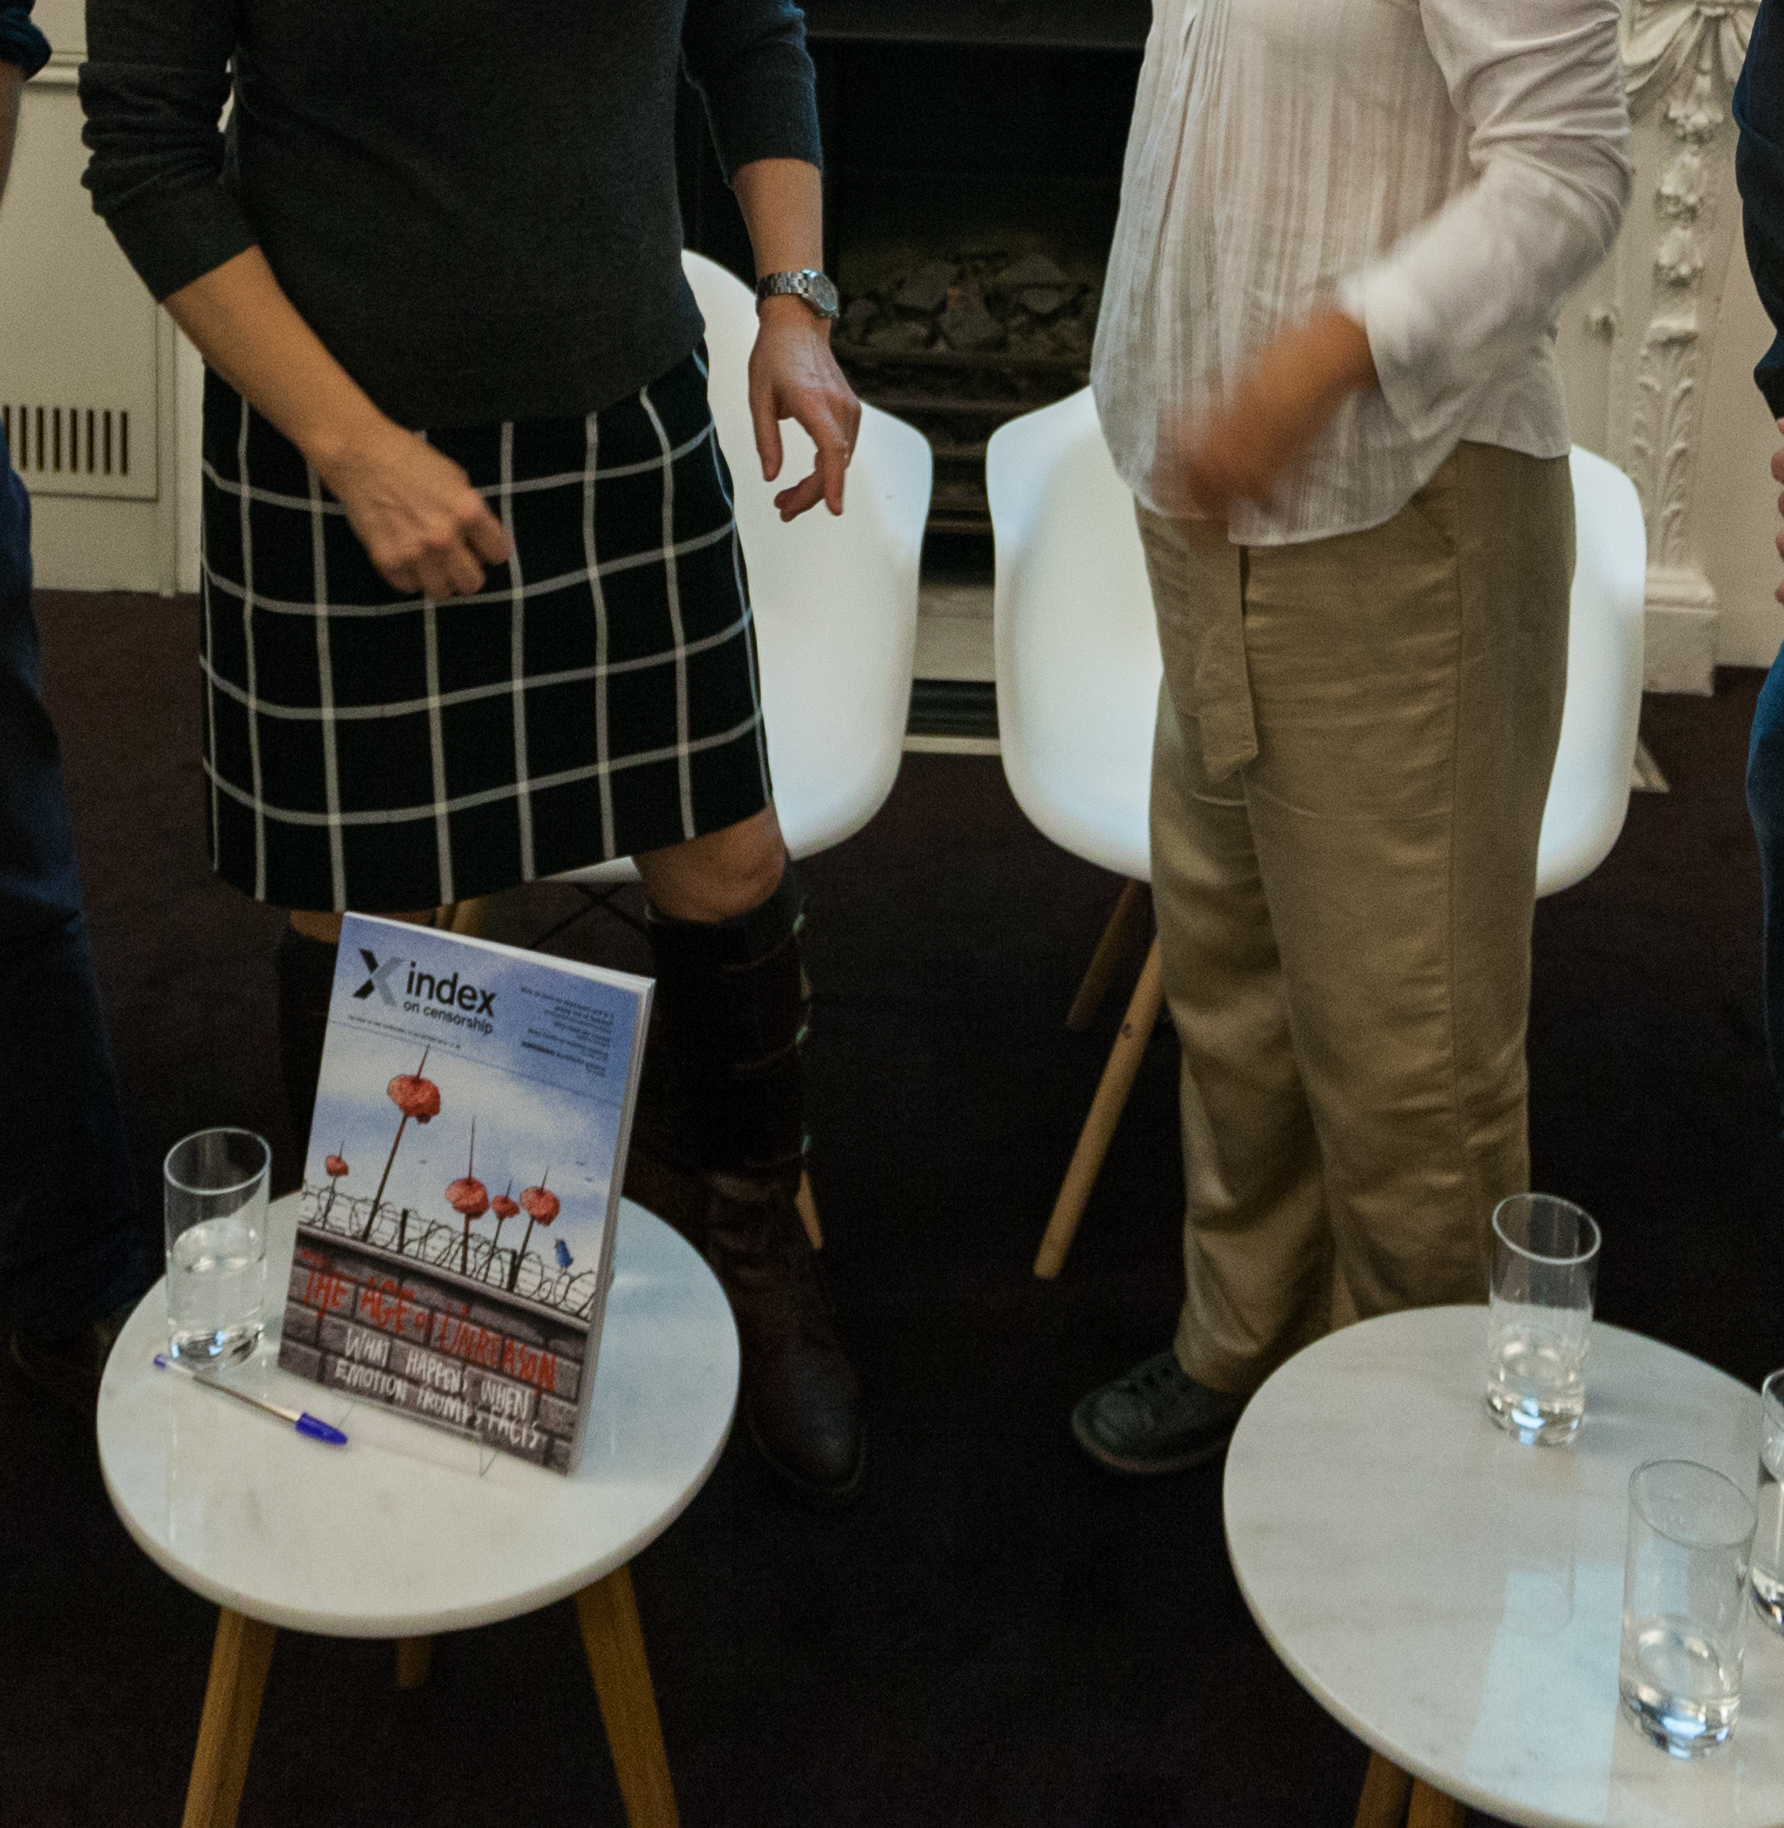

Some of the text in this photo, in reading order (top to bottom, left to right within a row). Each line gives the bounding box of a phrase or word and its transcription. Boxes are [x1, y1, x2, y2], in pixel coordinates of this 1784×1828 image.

[403, 1000, 420, 1013] on
[423, 1004, 493, 1036] censorship
[406, 960, 496, 1017] index
[300, 1248, 357, 1320] THE
[360, 1276, 415, 1332] AGE
[439, 1304, 557, 1396] UNREASON
[334, 1360, 407, 1402] EMOTION
[484, 1409, 541, 1449] FACTS
[344, 1326, 533, 1421] WHAT HAPPENS WHEN
